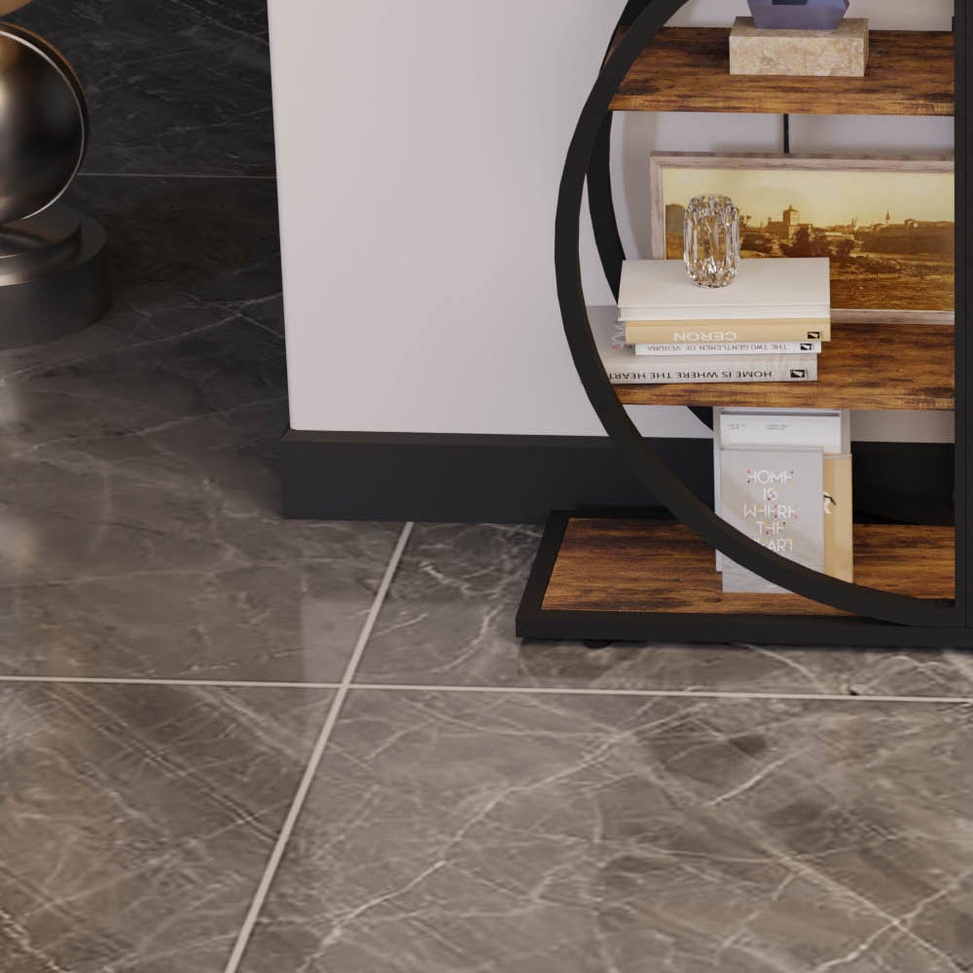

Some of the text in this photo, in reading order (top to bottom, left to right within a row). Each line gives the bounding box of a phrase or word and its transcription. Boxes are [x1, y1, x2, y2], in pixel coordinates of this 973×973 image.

[674, 331, 737, 341] CERON
[676, 371, 718, 379] WHERE
[721, 371, 732, 379] IS
[735, 370, 772, 379] HOME
[763, 487, 778, 501] IS
